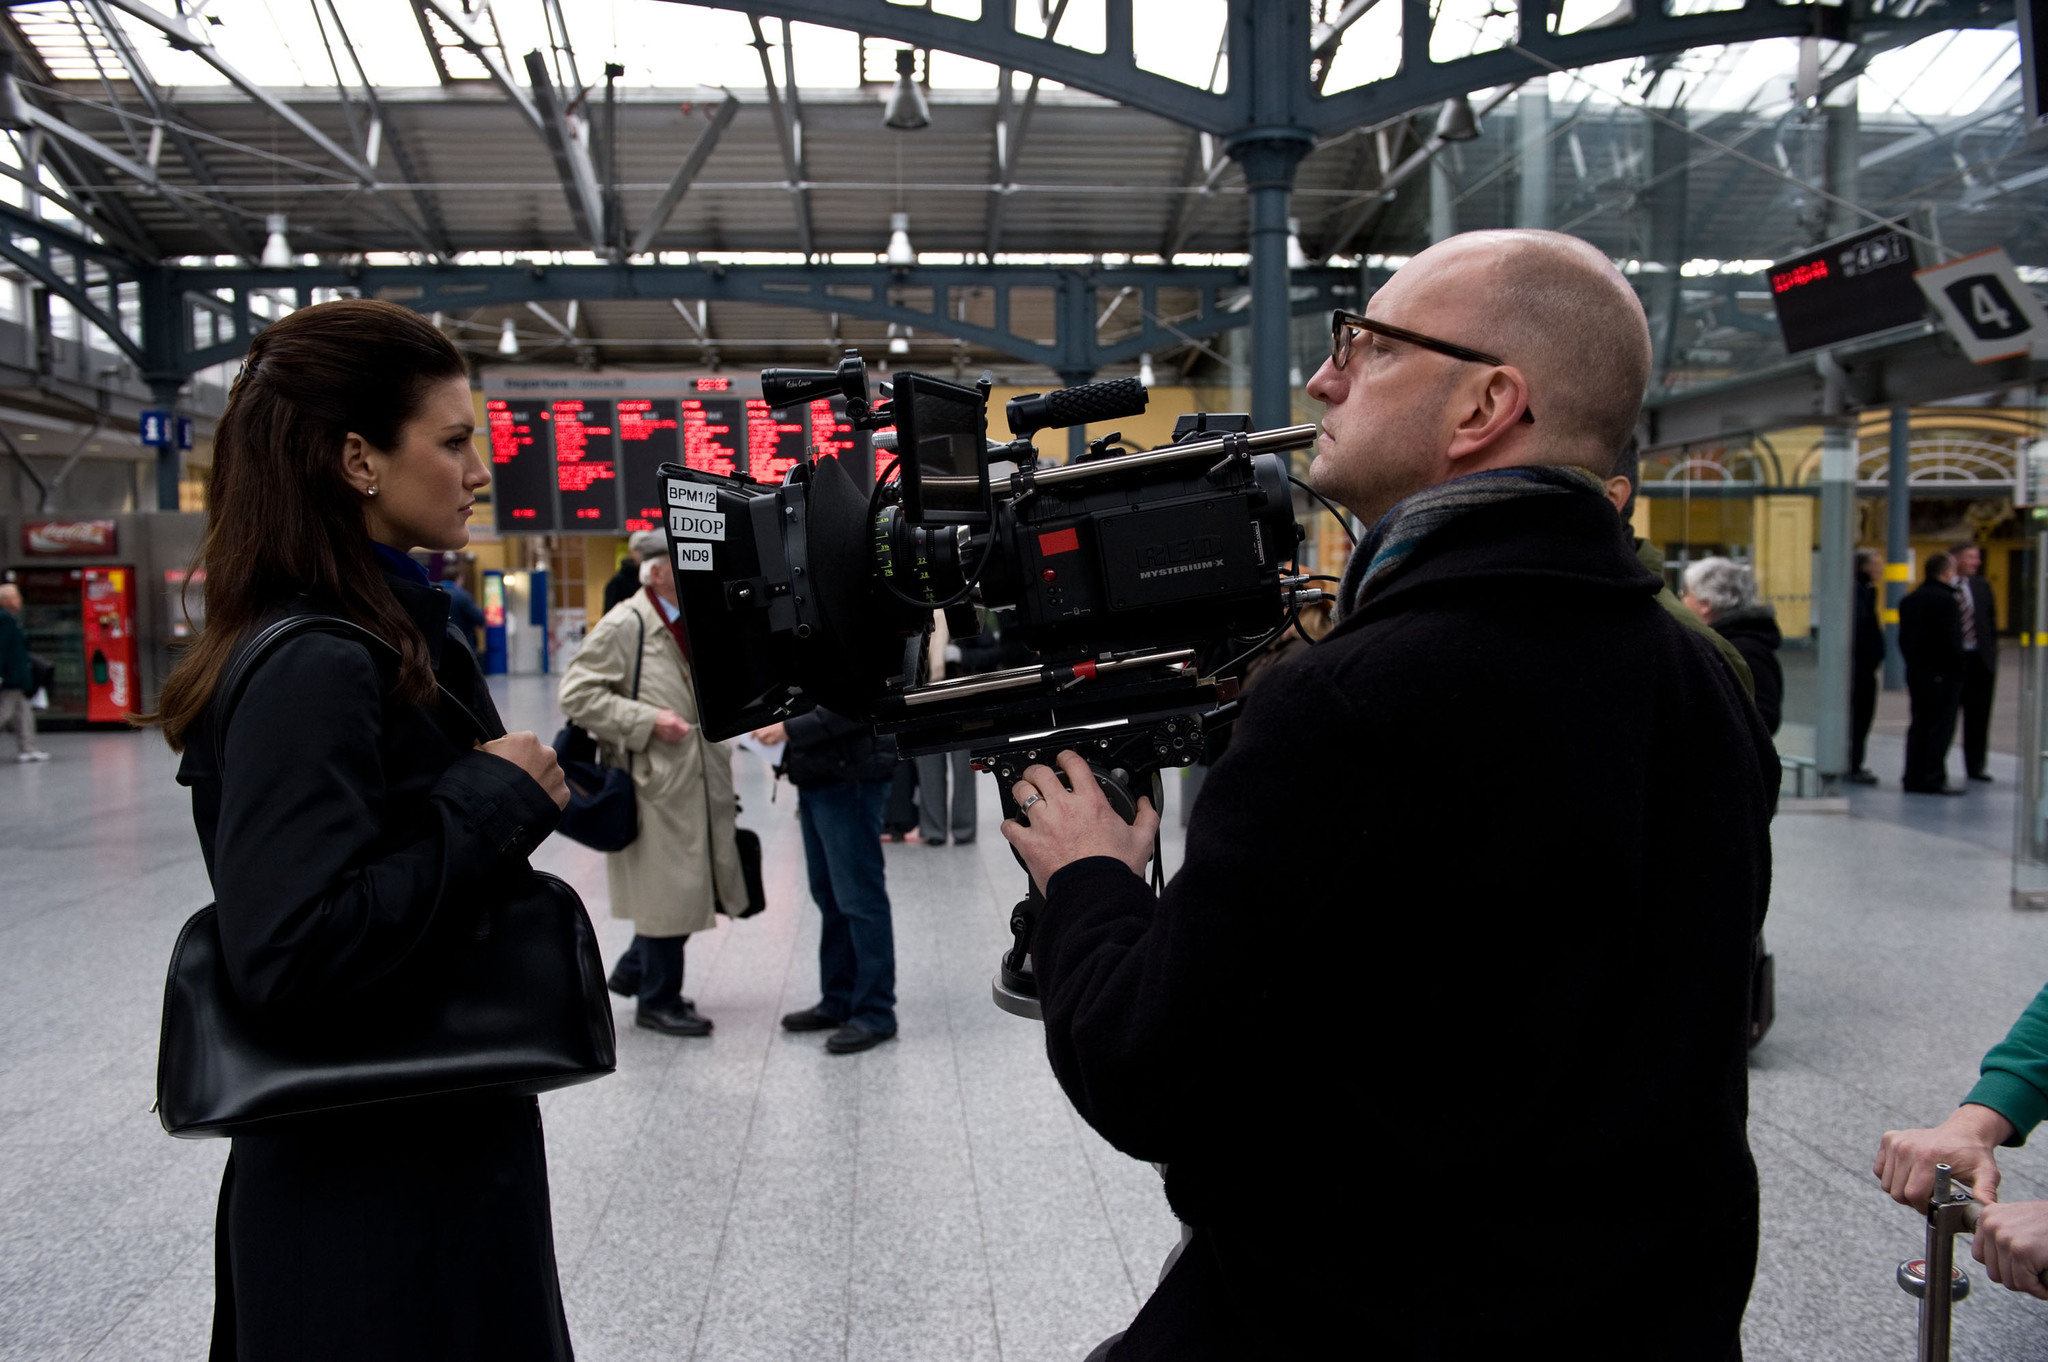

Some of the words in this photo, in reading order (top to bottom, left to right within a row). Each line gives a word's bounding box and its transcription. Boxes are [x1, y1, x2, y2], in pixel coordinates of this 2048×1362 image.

[1971, 283, 2012, 330] 4
[669, 487, 716, 505] BPM1/2
[682, 549, 709, 562] ND9
[1139, 558, 1225, 580] MYSTERIUM-X
